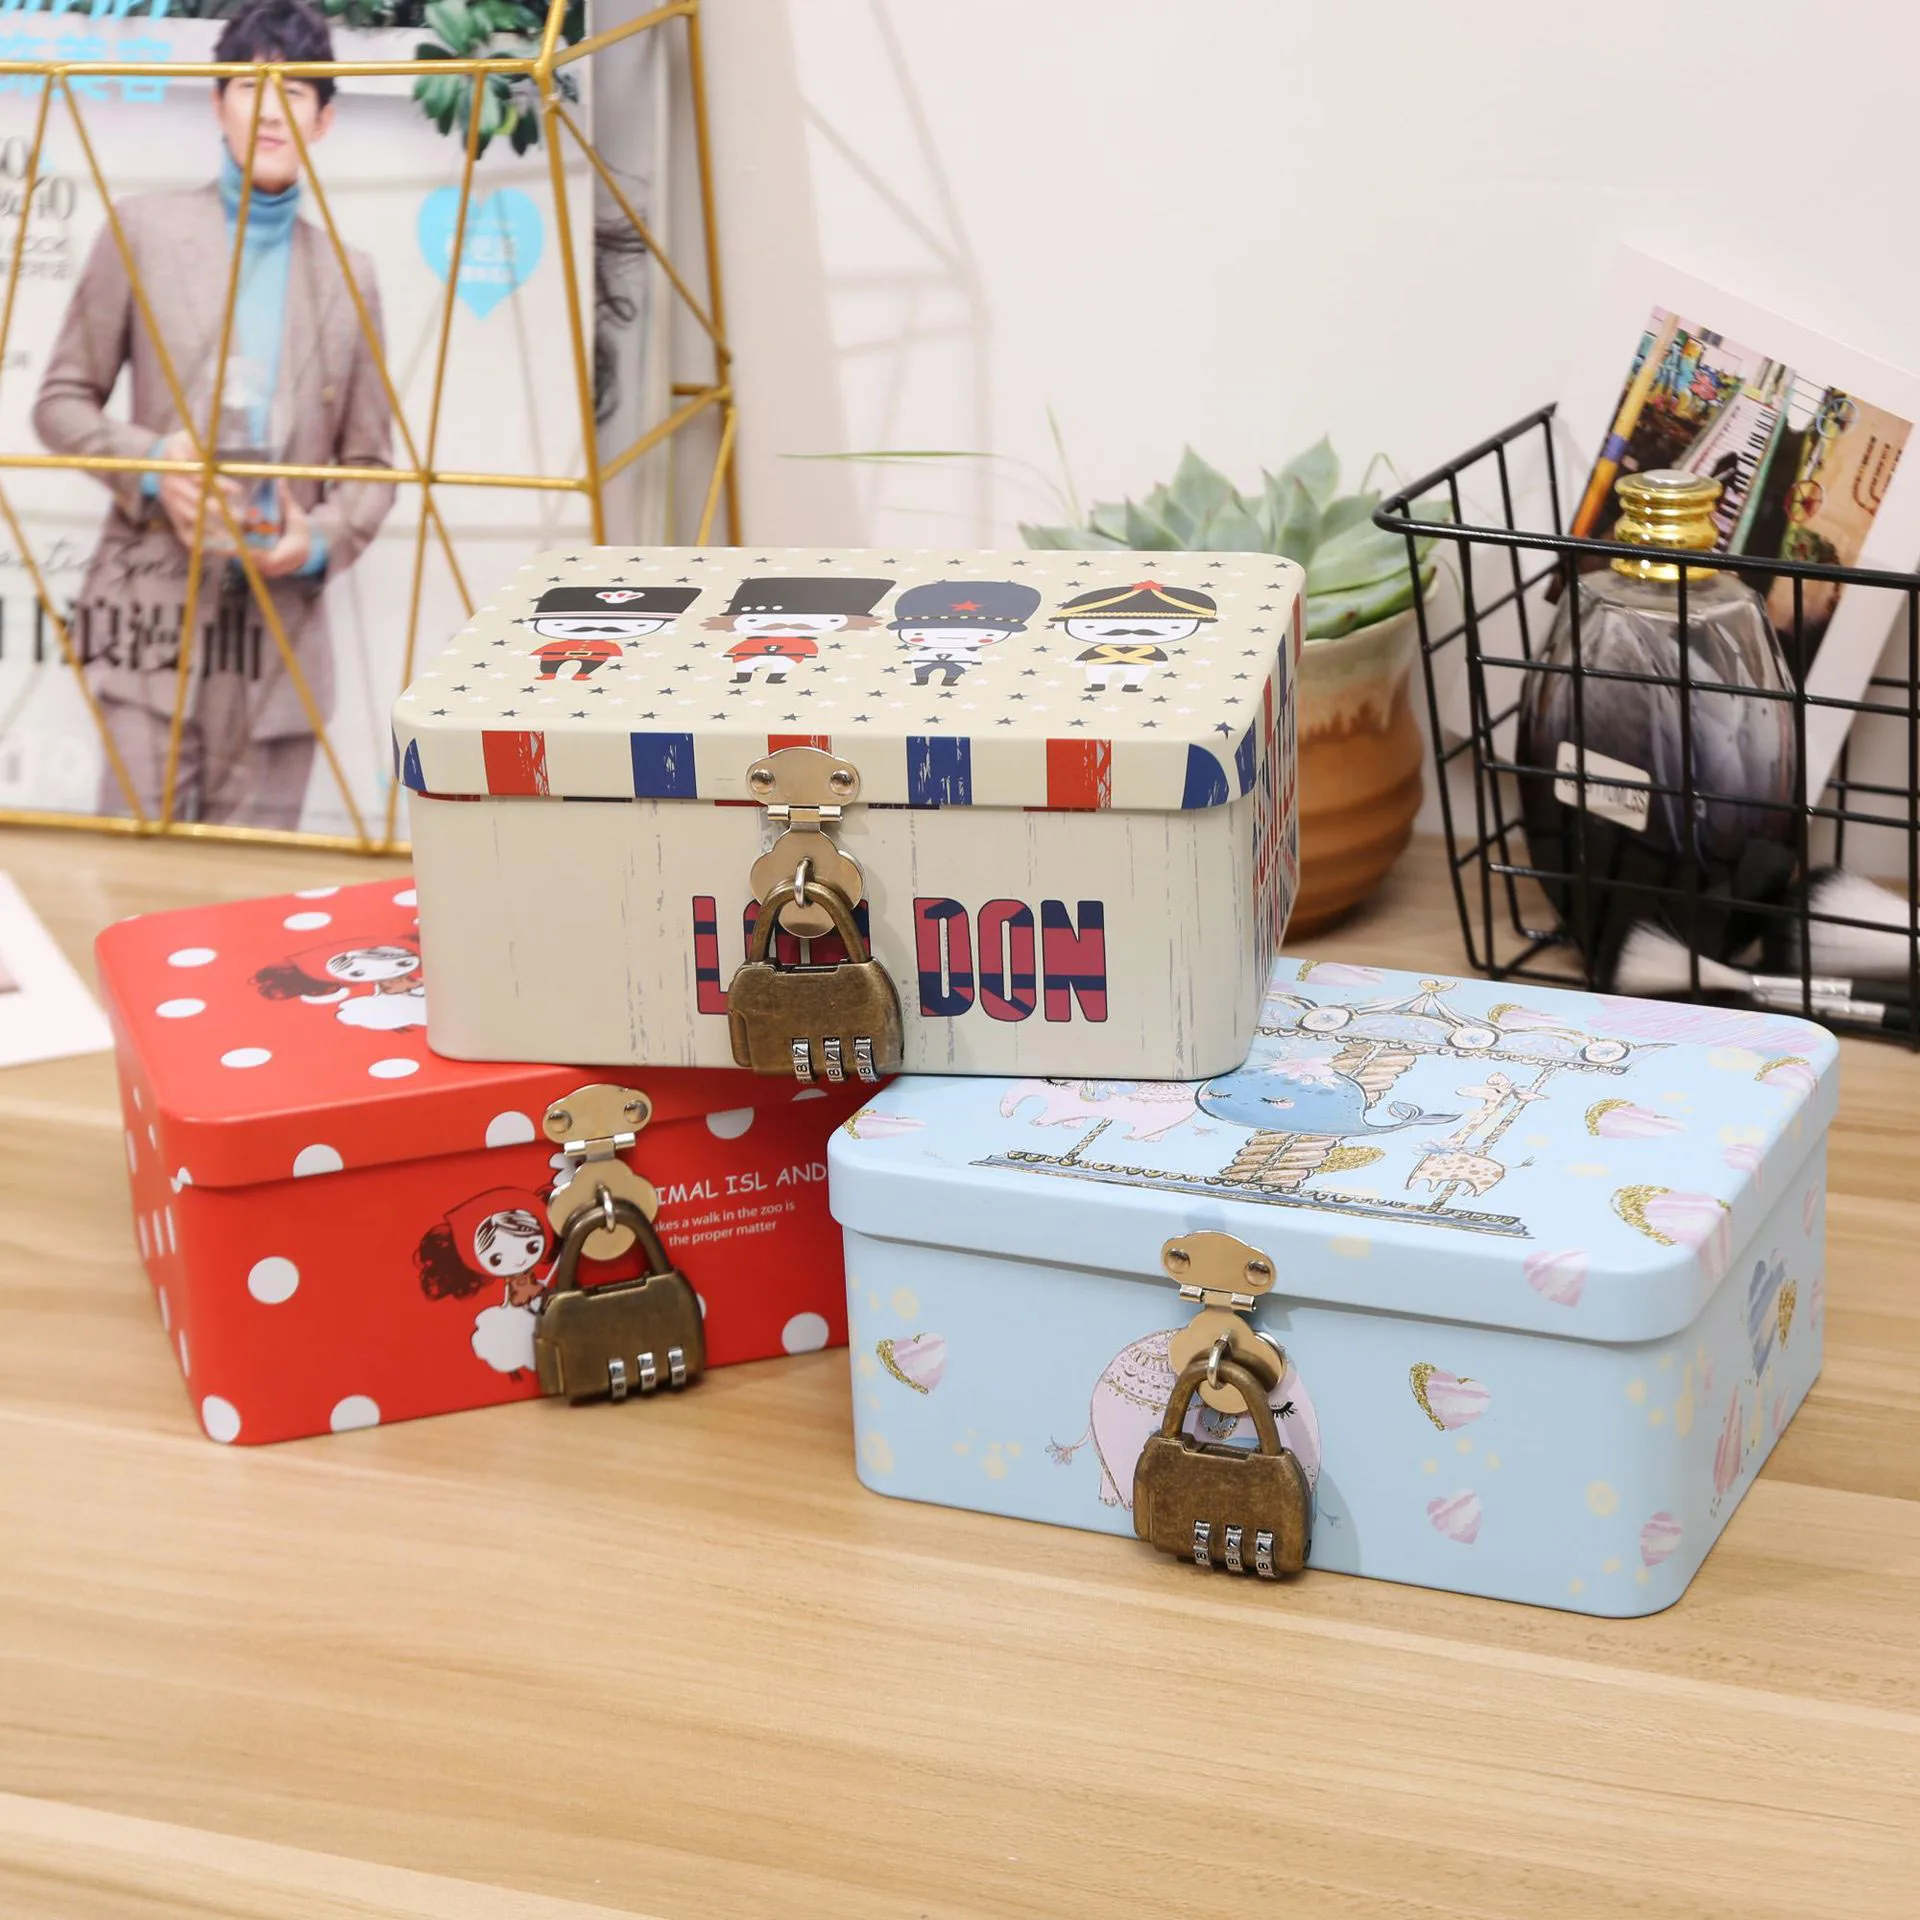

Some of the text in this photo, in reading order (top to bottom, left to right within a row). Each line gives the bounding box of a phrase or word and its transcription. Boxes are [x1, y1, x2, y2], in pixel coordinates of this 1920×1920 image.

[681, 1218, 689, 1228] a
[692, 1210, 720, 1226] walk
[723, 1209, 734, 1222] in
[737, 1206, 757, 1219] the
[760, 1203, 783, 1216] zoo
[785, 1200, 796, 1211] is
[668, 1220, 777, 1247] the proper matter
